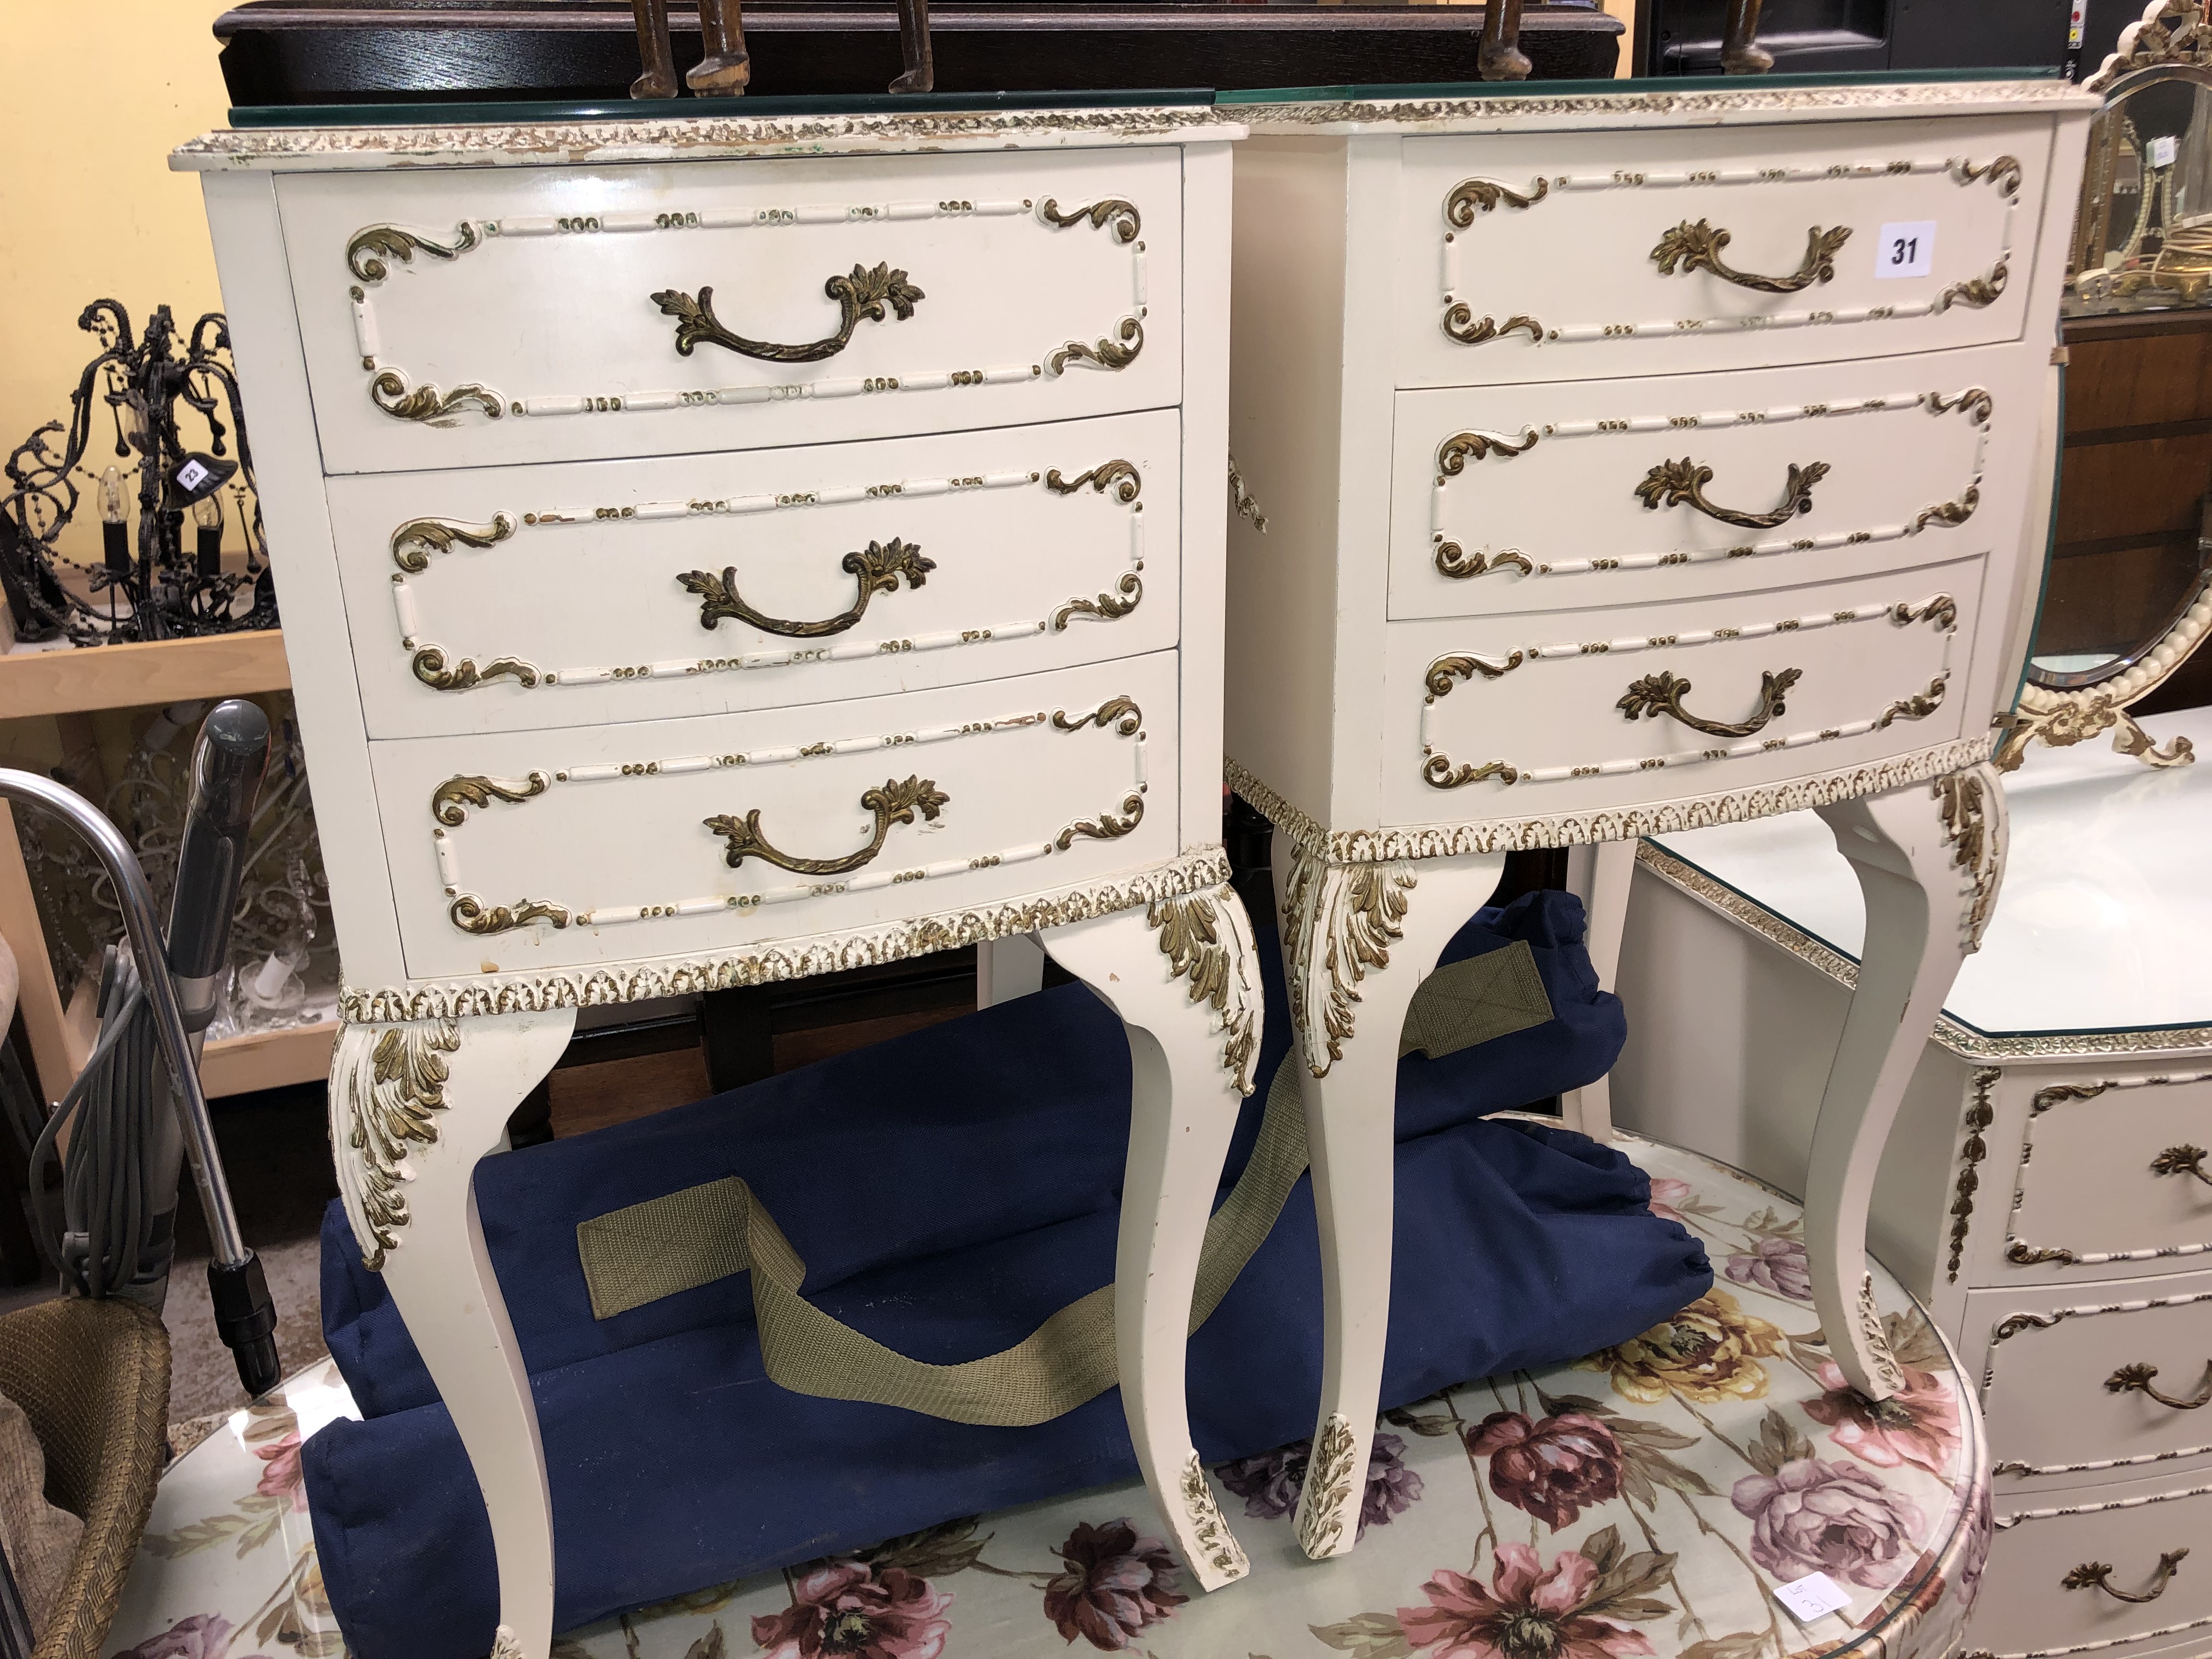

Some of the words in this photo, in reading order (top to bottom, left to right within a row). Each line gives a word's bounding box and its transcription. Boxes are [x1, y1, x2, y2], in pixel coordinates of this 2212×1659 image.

[1891, 237, 1918, 265] 31
[185, 468, 199, 482] 23
[1802, 1595, 1832, 1612] 31
